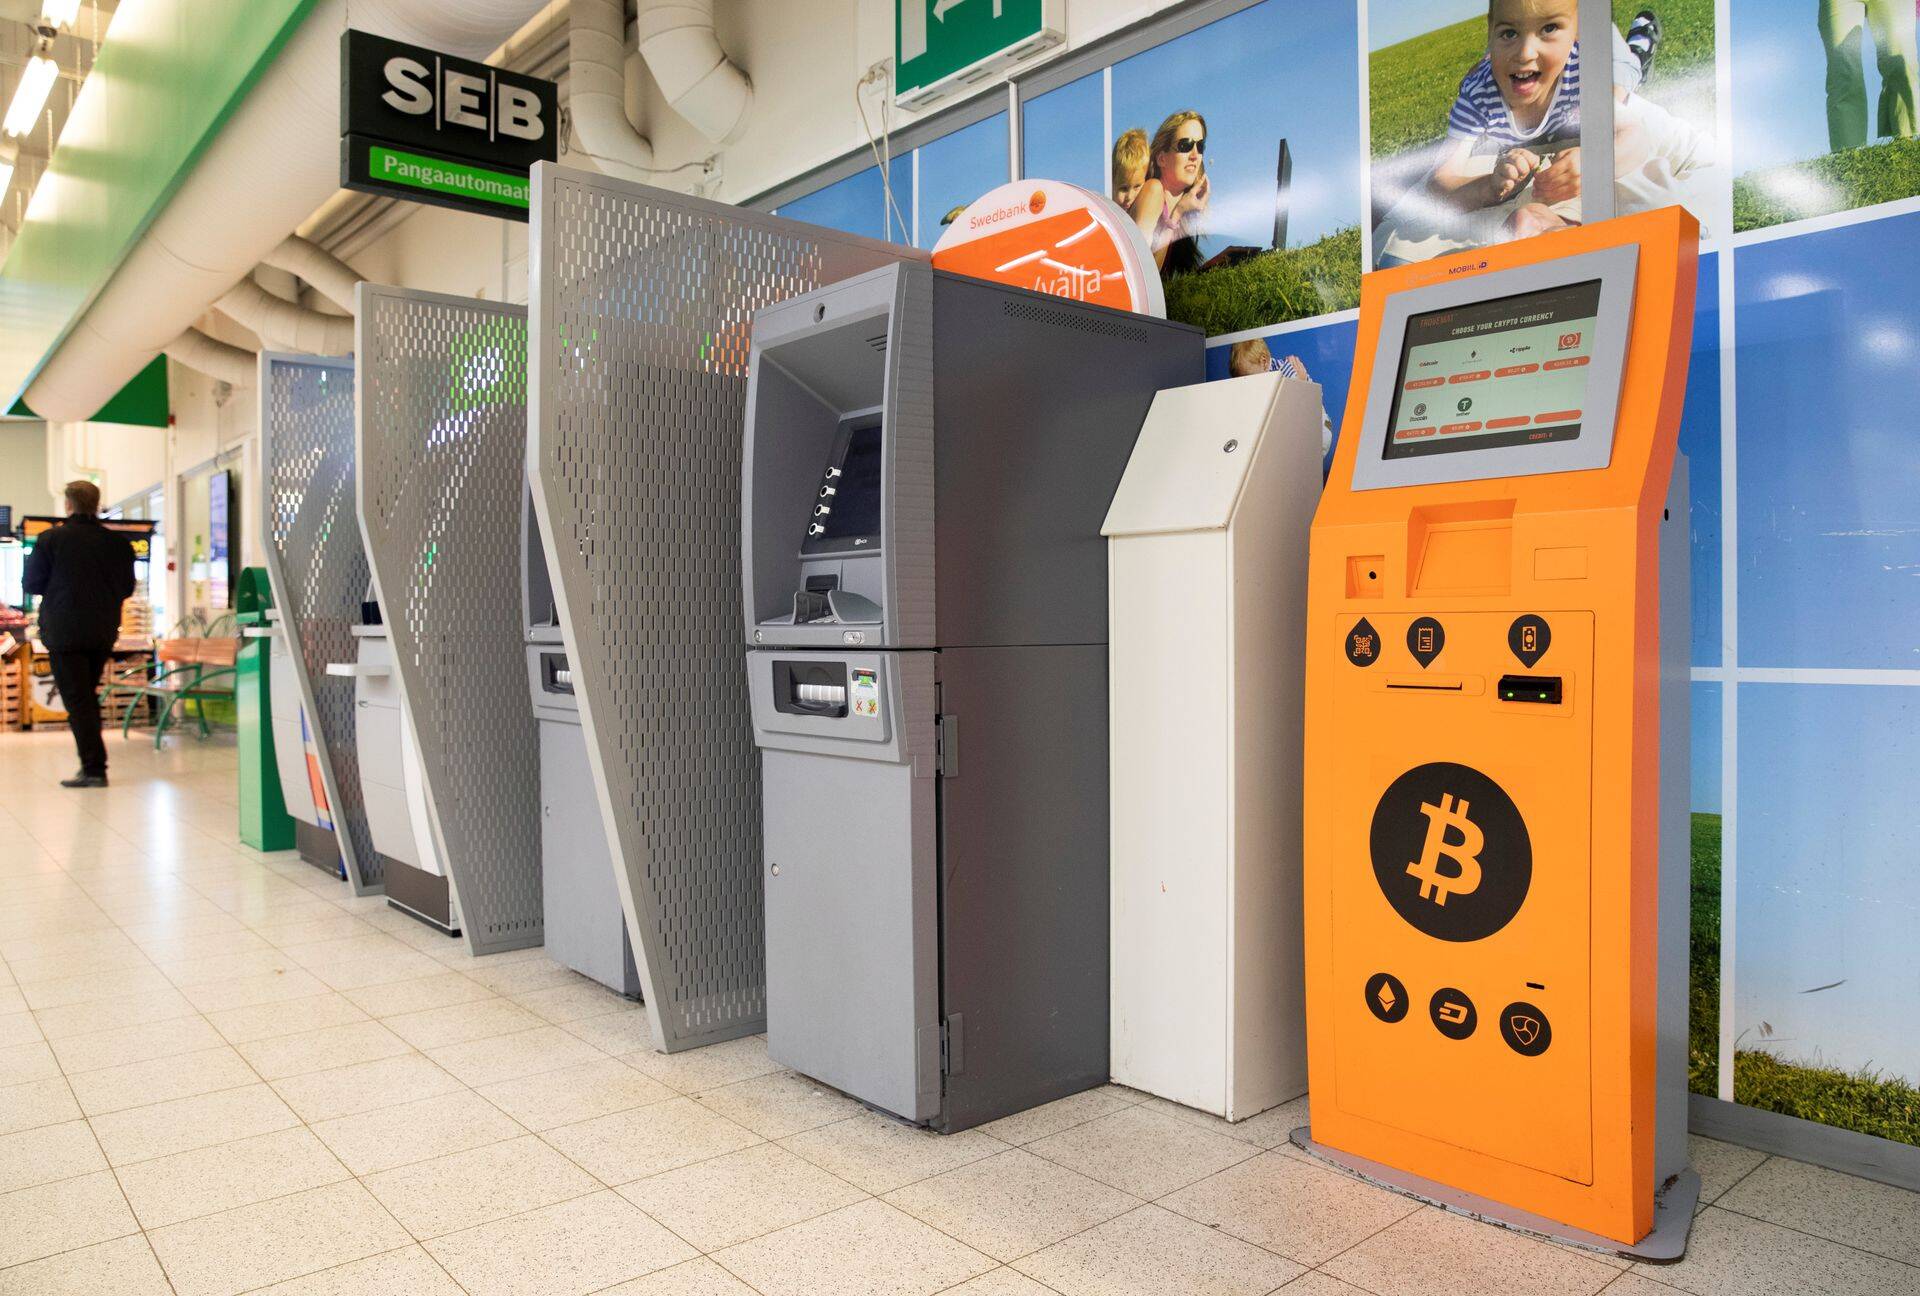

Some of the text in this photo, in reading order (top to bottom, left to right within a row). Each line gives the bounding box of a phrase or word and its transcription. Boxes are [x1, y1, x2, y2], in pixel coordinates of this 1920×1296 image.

[381, 56, 545, 142] SEB
[384, 154, 530, 201] Pangaautomaat
[970, 202, 1027, 230] Swedbank
[1023, 264, 1101, 301] /välja
[1451, 311, 1554, 336] CHOOSE YOUR CRYPTO CURRENCY
